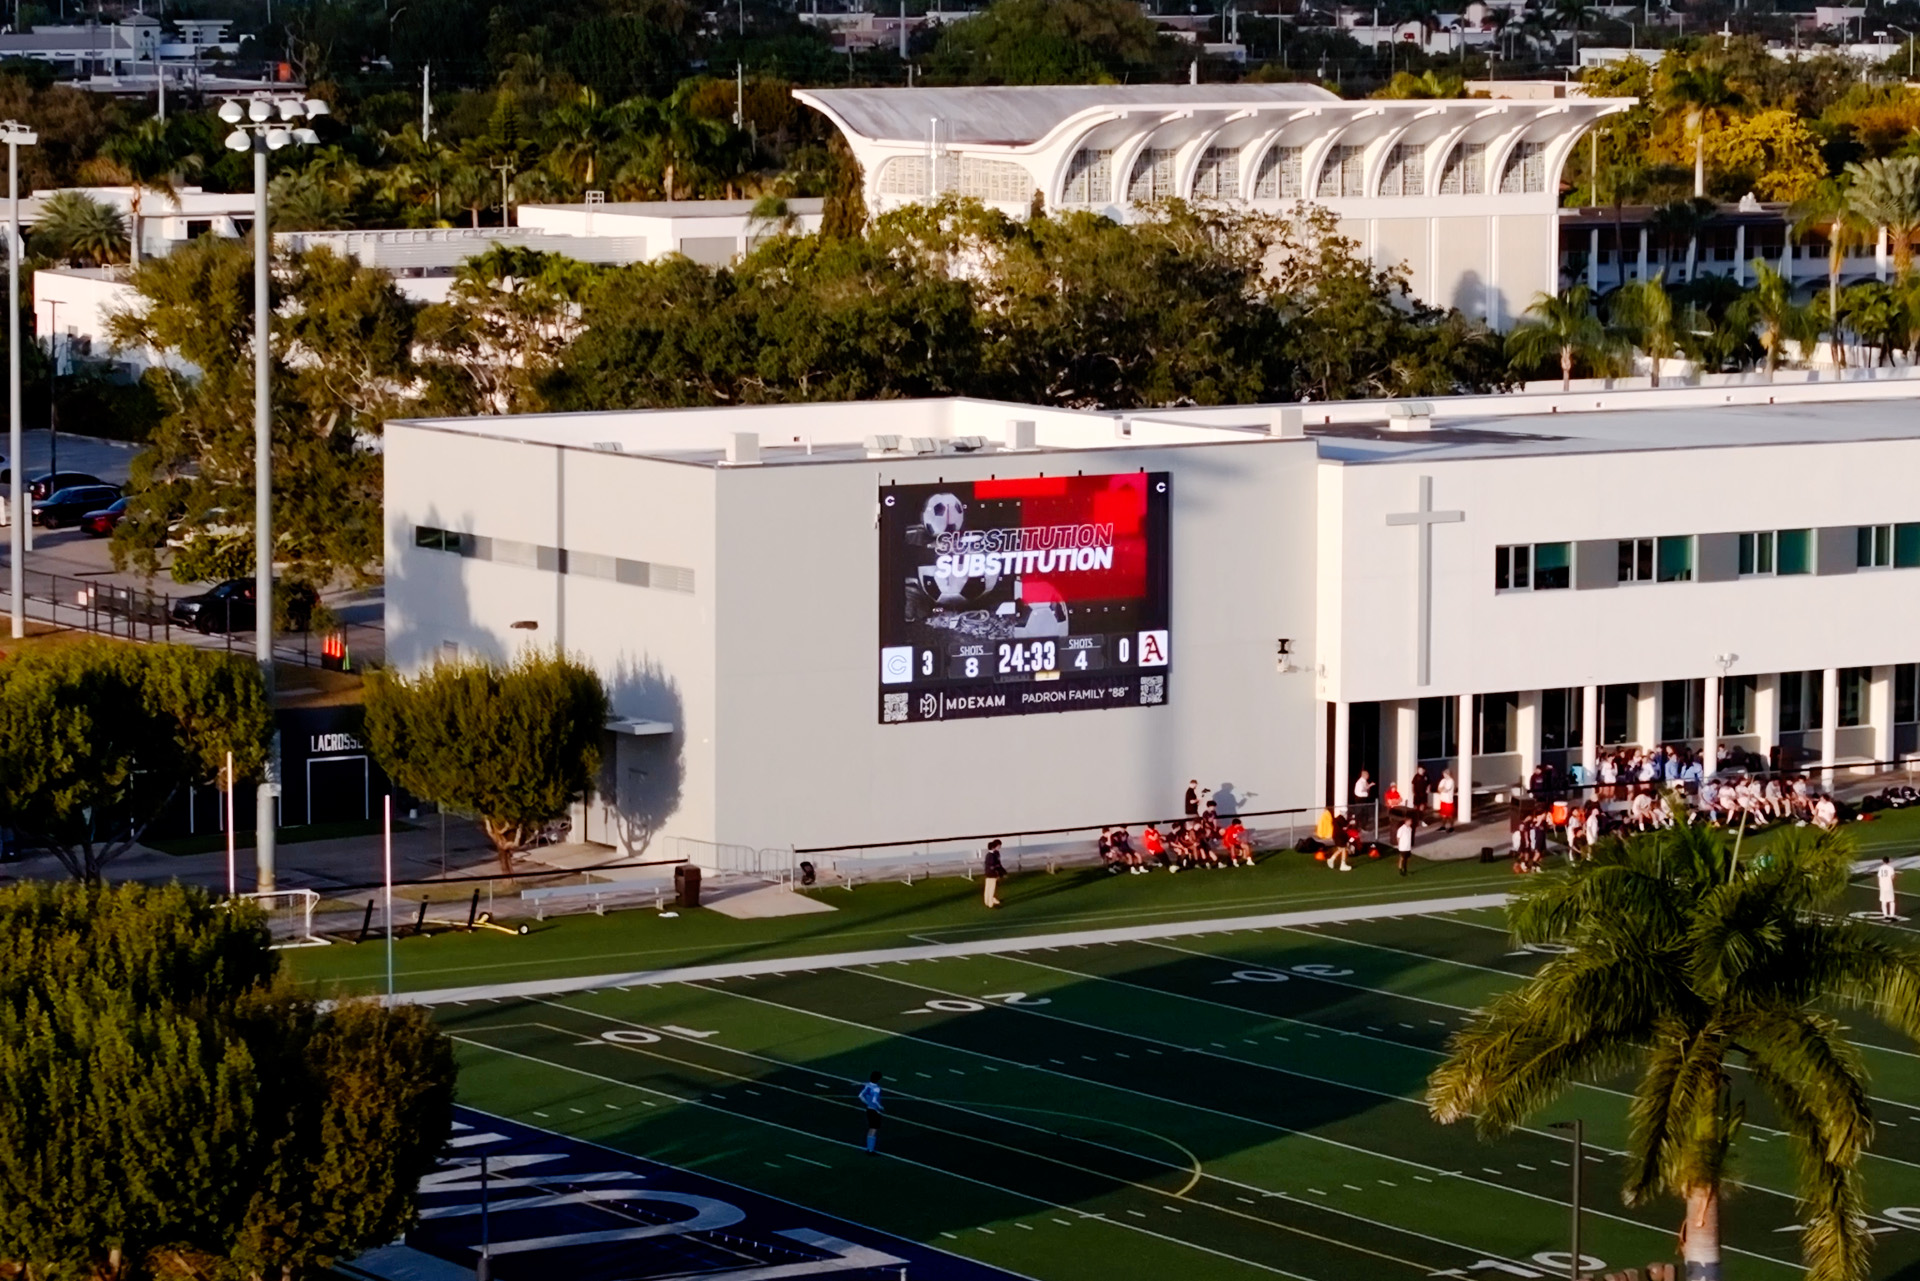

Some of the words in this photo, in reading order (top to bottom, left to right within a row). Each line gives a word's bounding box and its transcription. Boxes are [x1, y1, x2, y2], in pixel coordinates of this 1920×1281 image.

[935, 523, 1114, 556] SUBSTITUTION
[934, 546, 1114, 579] SUBSTITUTION
[959, 645, 984, 656] SHOTS
[1068, 637, 1093, 649] SHOTS
[1119, 638, 1130, 663] 0
[1142, 634, 1164, 663] A
[922, 650, 933, 676] 3
[965, 657, 979, 678] 8
[998, 641, 1056, 674] 24:33
[1074, 650, 1088, 671] 4
[946, 695, 1006, 710] MDEXAM
[1022, 691, 1067, 704] PADRON
[1069, 689, 1106, 700] FAMILY
[600, 1025, 720, 1044] 10
[1467, 1251, 1607, 1278] 10
